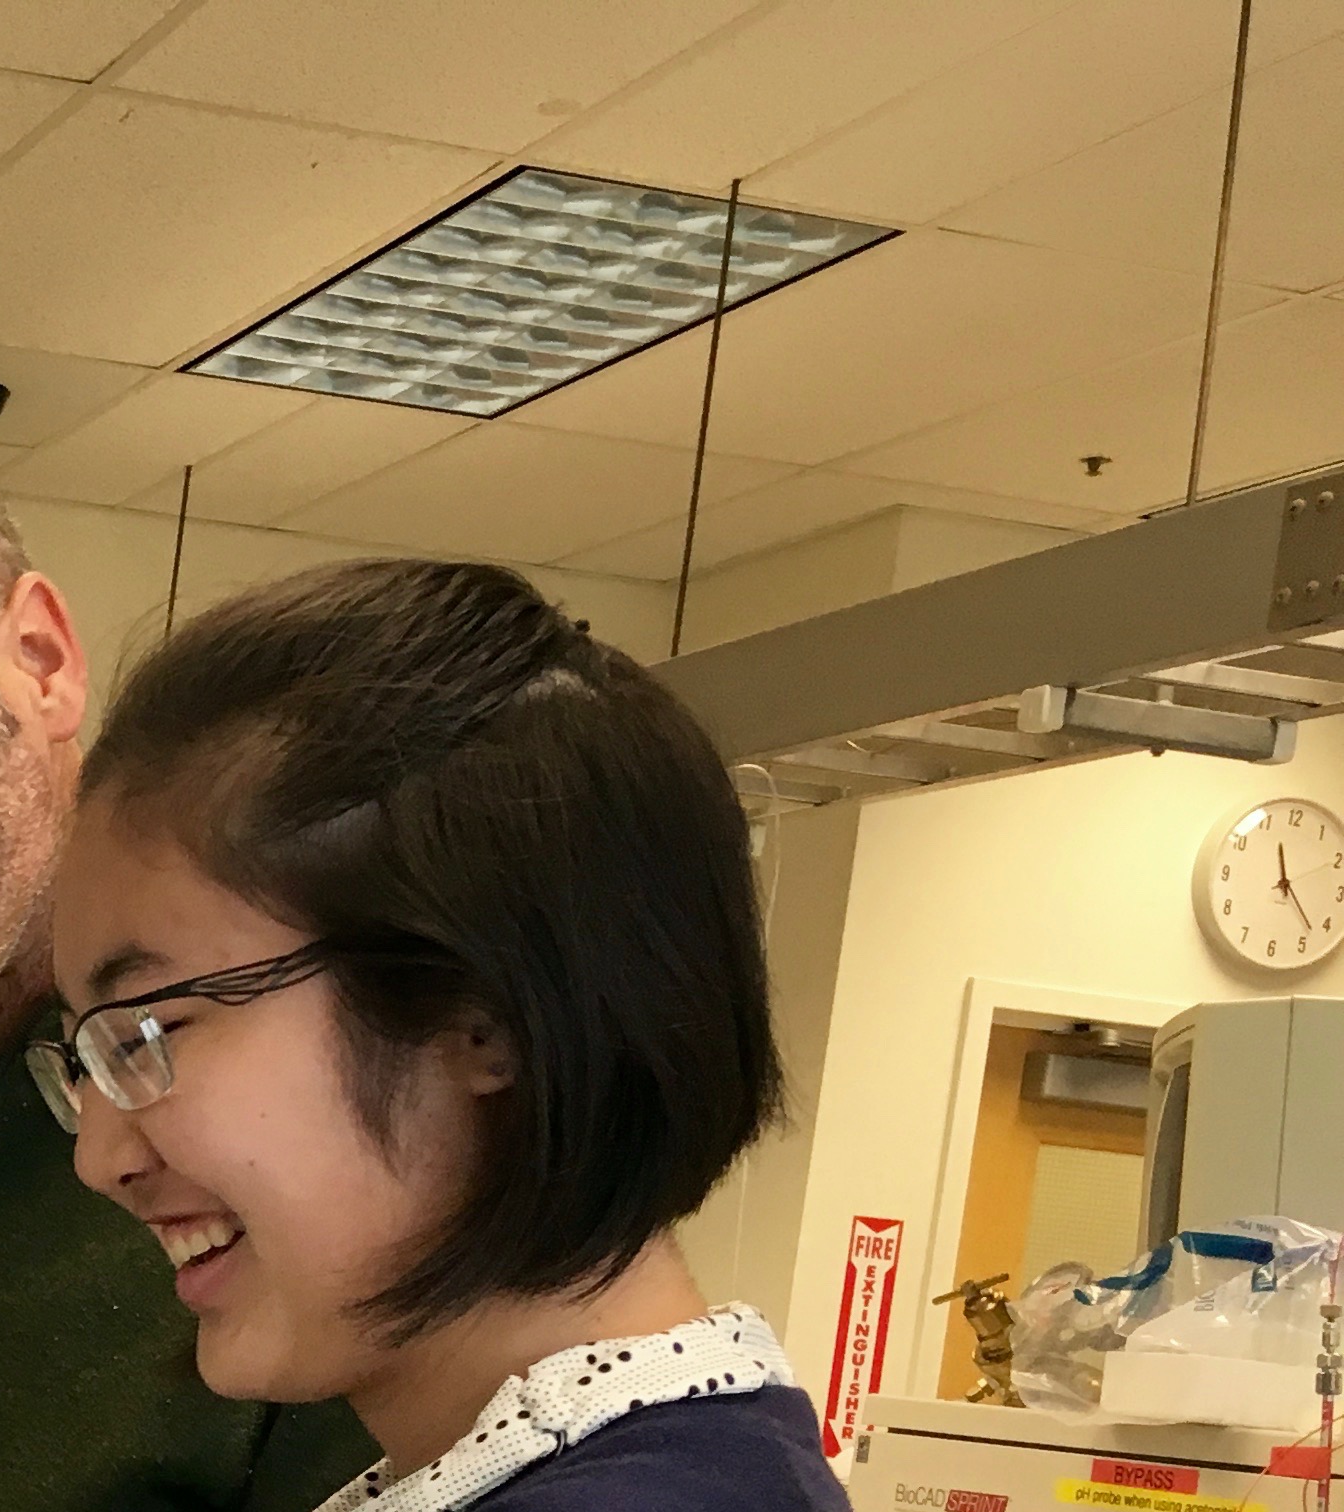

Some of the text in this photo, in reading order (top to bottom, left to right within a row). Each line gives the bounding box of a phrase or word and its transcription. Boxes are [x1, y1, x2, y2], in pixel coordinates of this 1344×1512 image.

[1289, 809, 1303, 827] 12
[1319, 825, 1325, 840] 1
[1334, 853, 1342, 869] 2
[1221, 865, 1230, 881] 9
[1336, 886, 1344, 902] 3
[1224, 899, 1232, 915] 8
[1322, 917, 1331, 932] 4
[1241, 927, 1249, 943] 7
[1267, 940, 1276, 957] 6
[1298, 937, 1306, 953] 5
[855, 1236, 894, 1261] FIRE
[841, 1265, 877, 1439] EXTINGUISHER
[1114, 1466, 1174, 1490] BYPASS
[1076, 1487, 1090, 1501] pH
[1092, 1491, 1121, 1505] probe
[1124, 1494, 1151, 1509] when
